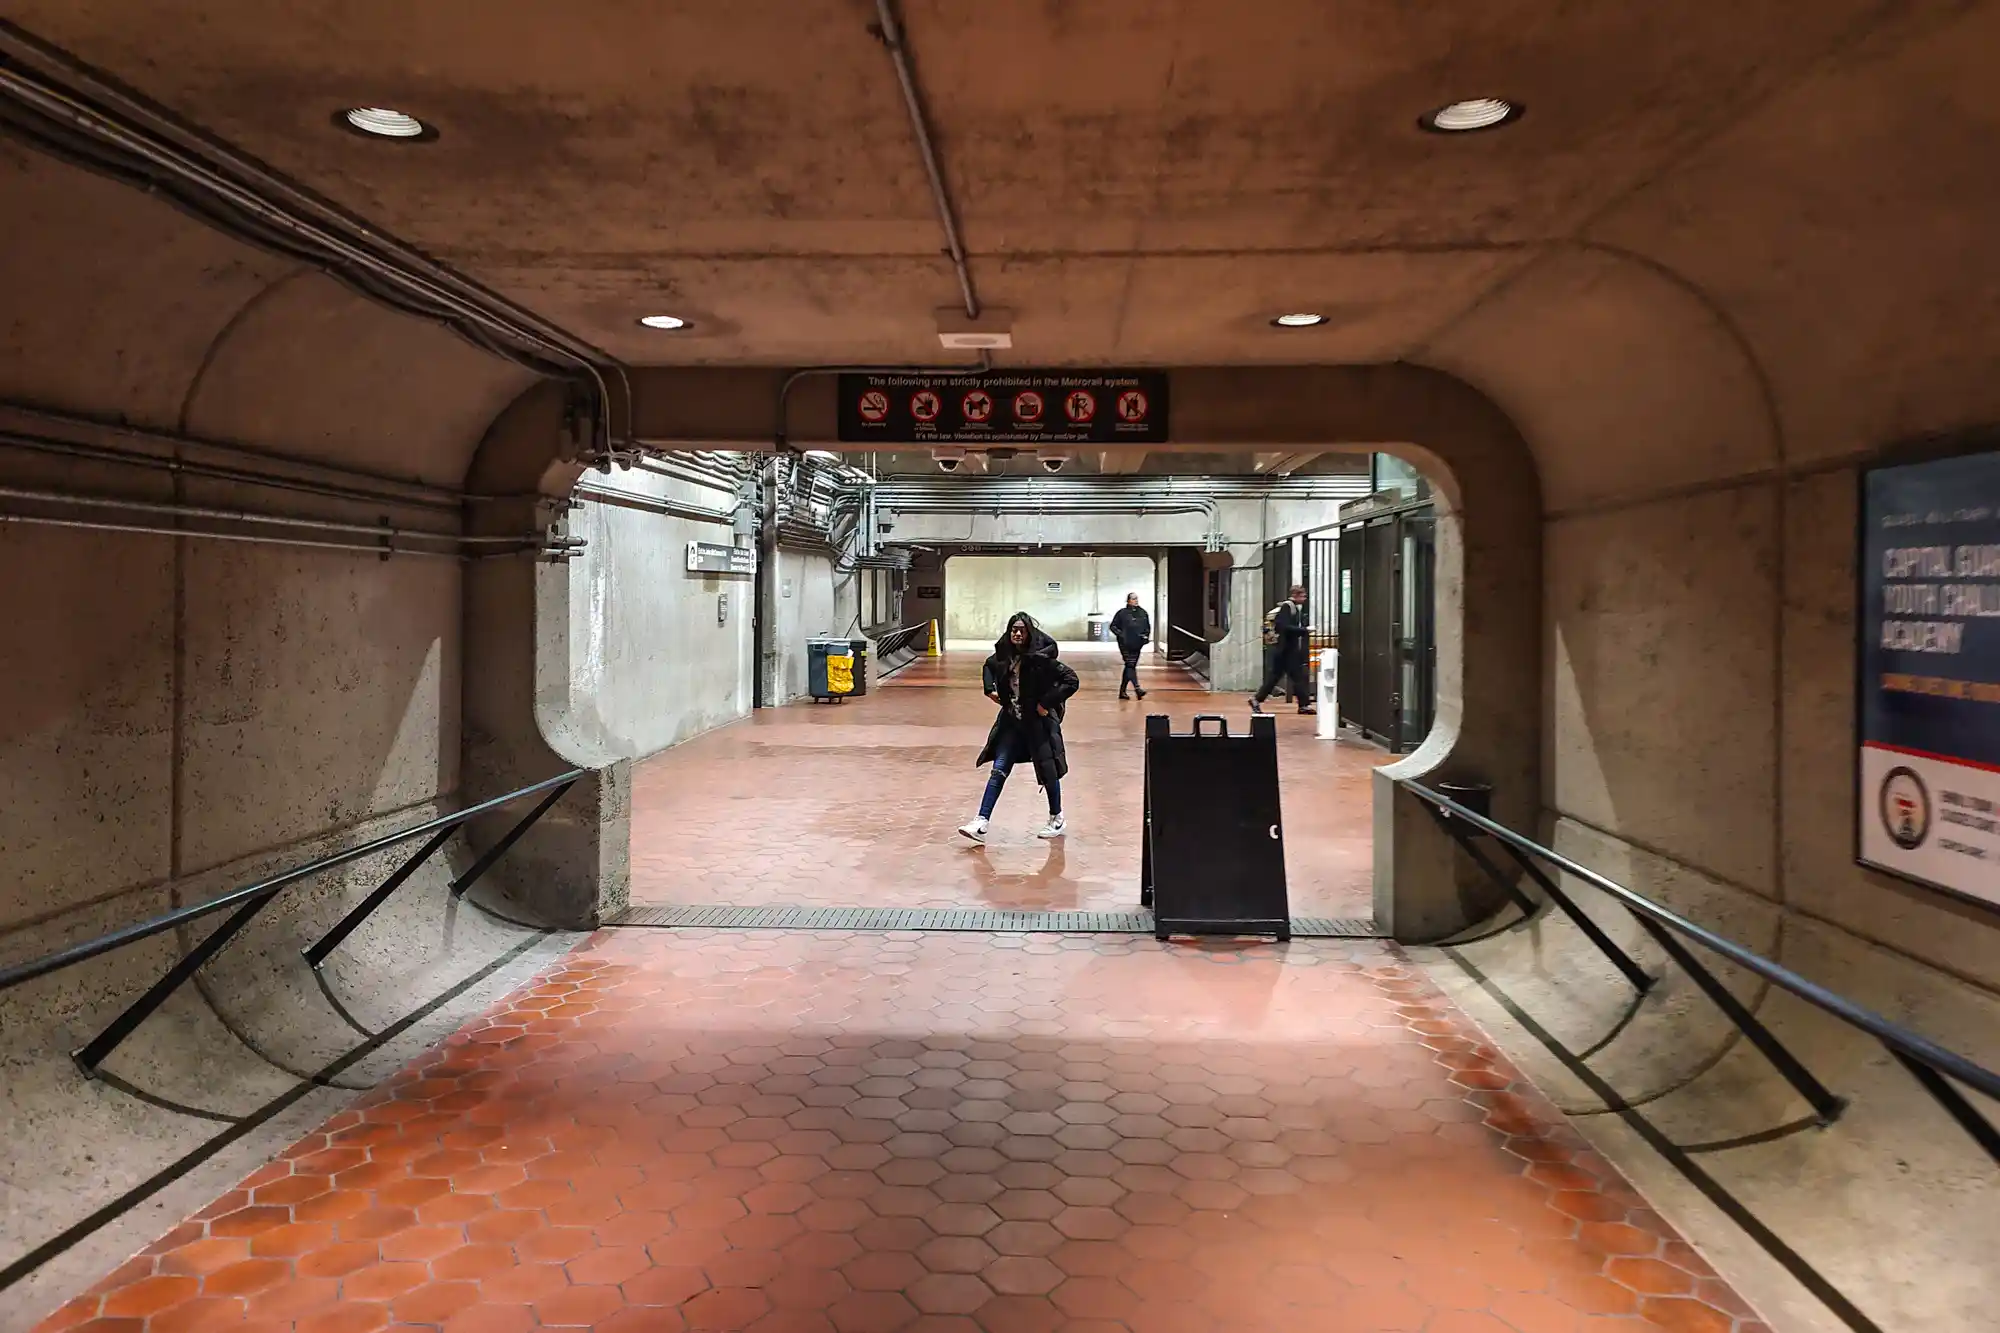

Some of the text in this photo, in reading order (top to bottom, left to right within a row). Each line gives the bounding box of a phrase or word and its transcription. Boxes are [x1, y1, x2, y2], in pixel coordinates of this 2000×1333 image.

[868, 376, 1139, 388] The following are strictly prohibited in the Metrorail system
